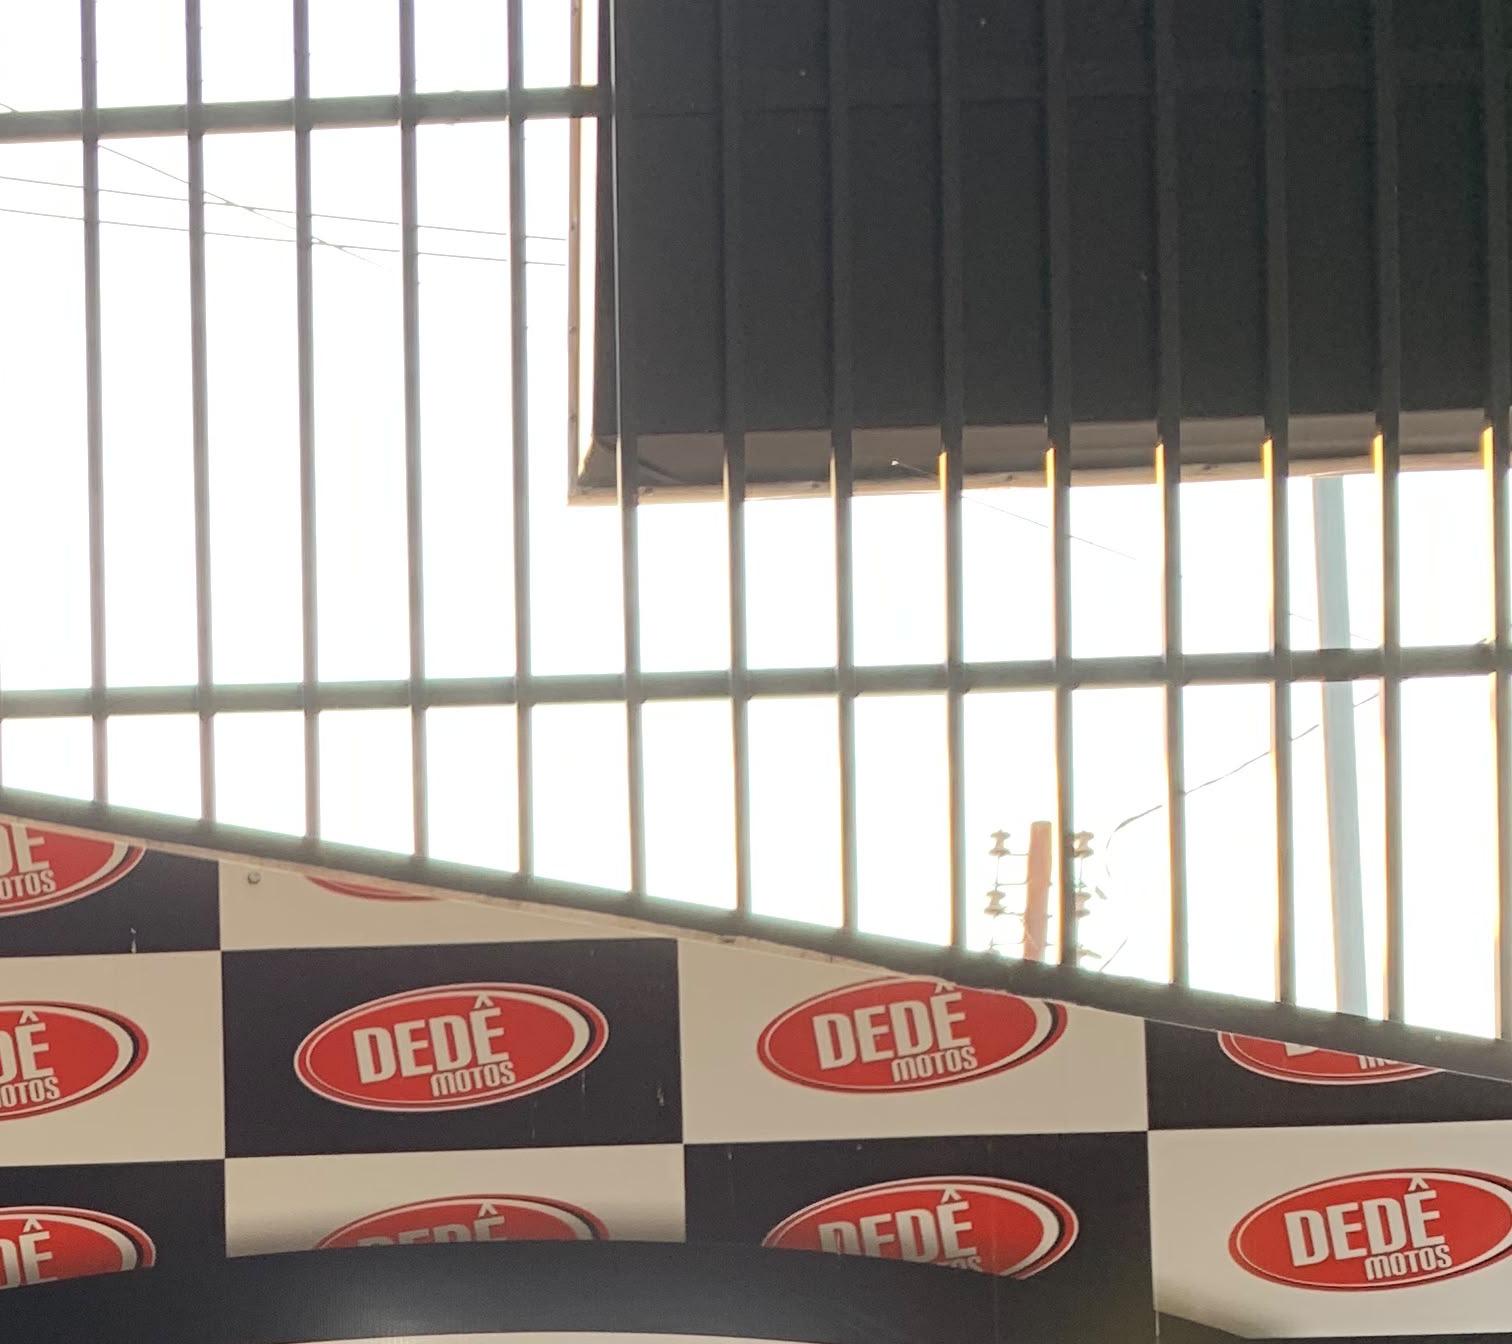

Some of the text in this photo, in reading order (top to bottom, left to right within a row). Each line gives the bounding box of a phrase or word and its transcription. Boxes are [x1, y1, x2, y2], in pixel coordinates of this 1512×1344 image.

[353, 993, 510, 1084] DEDÊ
[430, 1061, 516, 1098] MOTOS
[891, 1047, 978, 1083] MOTOS
[1284, 1176, 1446, 1267] DEDÊ
[1364, 1244, 1452, 1281] MOTOS
